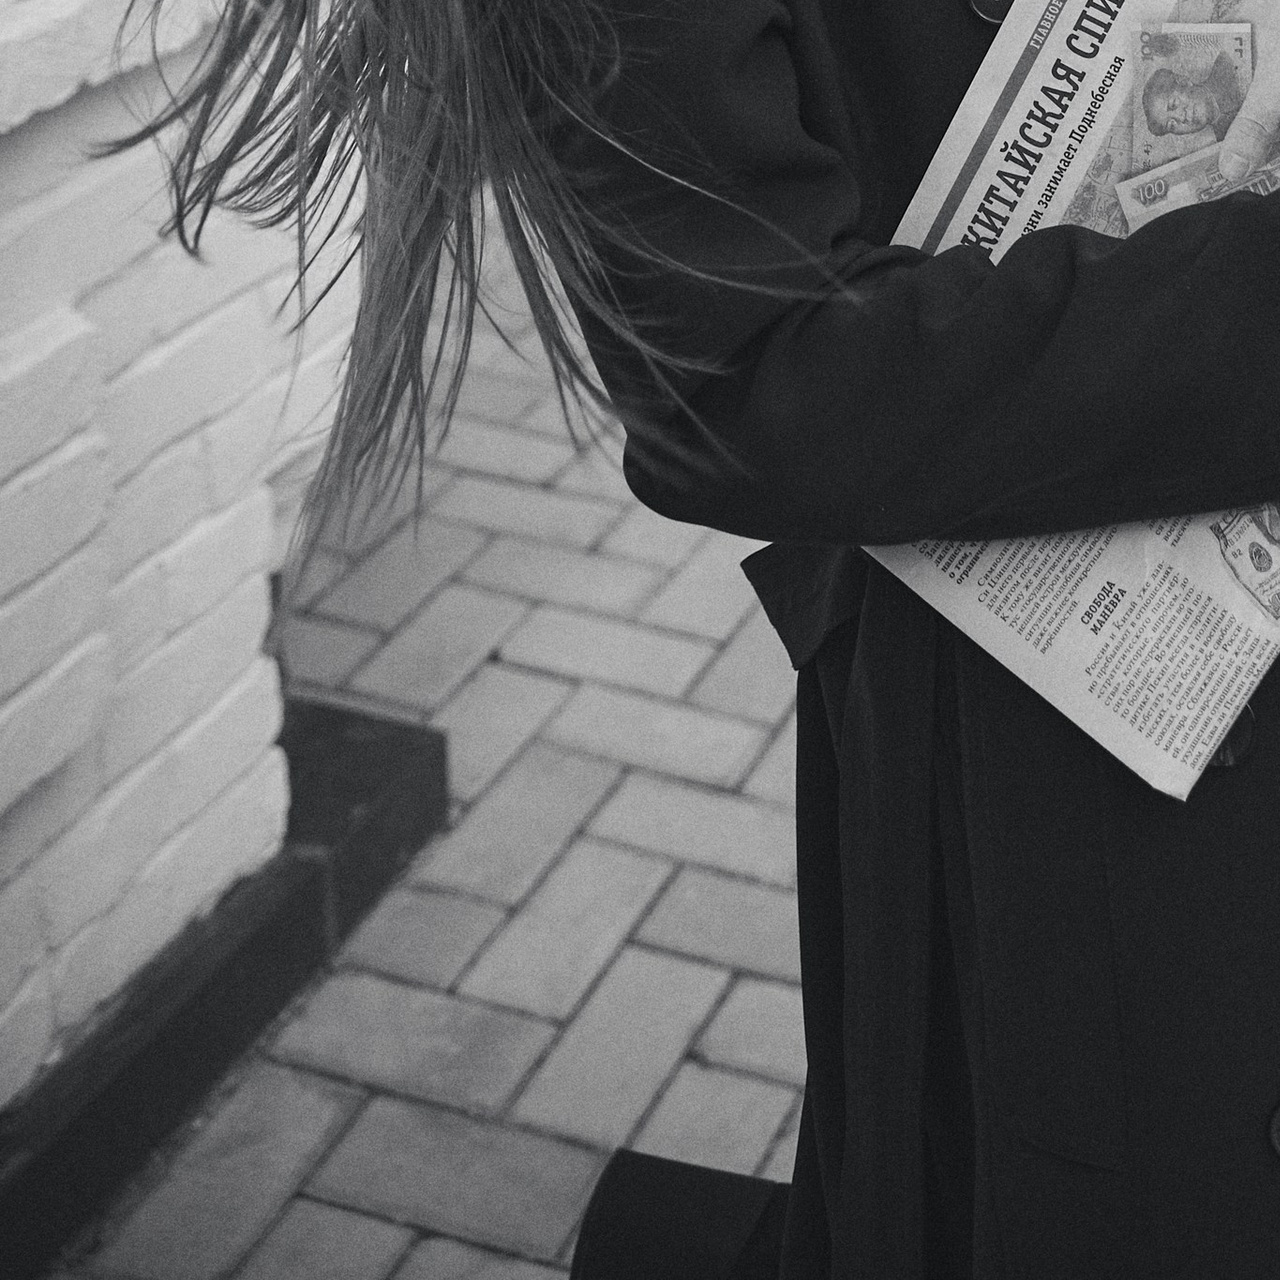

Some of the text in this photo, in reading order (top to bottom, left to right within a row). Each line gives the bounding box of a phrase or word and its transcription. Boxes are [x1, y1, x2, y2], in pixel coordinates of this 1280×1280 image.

[960, 57, 1087, 258] КИТАЙСКАЯ
[1037, 143, 1078, 210] занимает
[1068, 55, 1126, 145] Поднебесная
[1138, 179, 1166, 204] 100
[986, 593, 999, 612] для
[997, 574, 1013, 595] него
[1011, 540, 1037, 575] первым
[993, 579, 1021, 617] визитом
[1019, 554, 1040, 581] после
[1007, 590, 1025, 613] тому
[1032, 552, 1052, 579] визит
[1016, 601, 1042, 636] нешней
[1039, 574, 1062, 603] острой
[1024, 601, 1054, 642] ситуации
[1051, 562, 1082, 602] подобная
[1032, 626, 1049, 650] даже
[1046, 595, 1070, 627] важнее
[1067, 546, 1105, 597] конкретных
[1080, 580, 1116, 625] СВОБОДА
[1084, 642, 1111, 677] Россия
[1113, 600, 1138, 631] Китай
[1136, 581, 1152, 601] уже
[1150, 559, 1165, 581] дав-
[1089, 588, 1127, 636] МАНЁВРА
[1151, 592, 1182, 634] впрочем,
[1007, 613, 1021, 629] тус
[1096, 628, 1131, 680] пребывают
[1135, 564, 1174, 621] отношениях
[1096, 616, 1152, 700] «стратегического
[1112, 696, 1125, 714] сих
[1121, 679, 1136, 697] пор
[1140, 614, 1178, 669] перерастали
[1182, 583, 1199, 603] что-
[1128, 595, 1213, 728] литике Пекин всегда старался
[1165, 607, 1194, 650] внешней
[1192, 590, 1204, 607] по-
[1137, 692, 1165, 734] избегать
[1162, 651, 1190, 692] участия
[1194, 602, 1219, 642] полити-
[1144, 707, 1170, 739] ческих,
[1170, 680, 1184, 698] тем
[1180, 654, 1201, 681] более
[1202, 607, 1229, 648] военных
[1153, 613, 1237, 747] союзах, оставляя себе свободу
[1180, 715, 1213, 766] ухудшения
[1210, 665, 1244, 716] отношений
[1242, 634, 1261, 658] Запа-
[1186, 661, 1221, 711] Сближаясь
[1221, 622, 1244, 653] Росси-
[1187, 669, 1228, 732] одновременно
[1233, 626, 1254, 659] желает
[1200, 725, 1219, 747] Едва
[1223, 680, 1246, 711] Пекин
[1243, 661, 1258, 680] при
